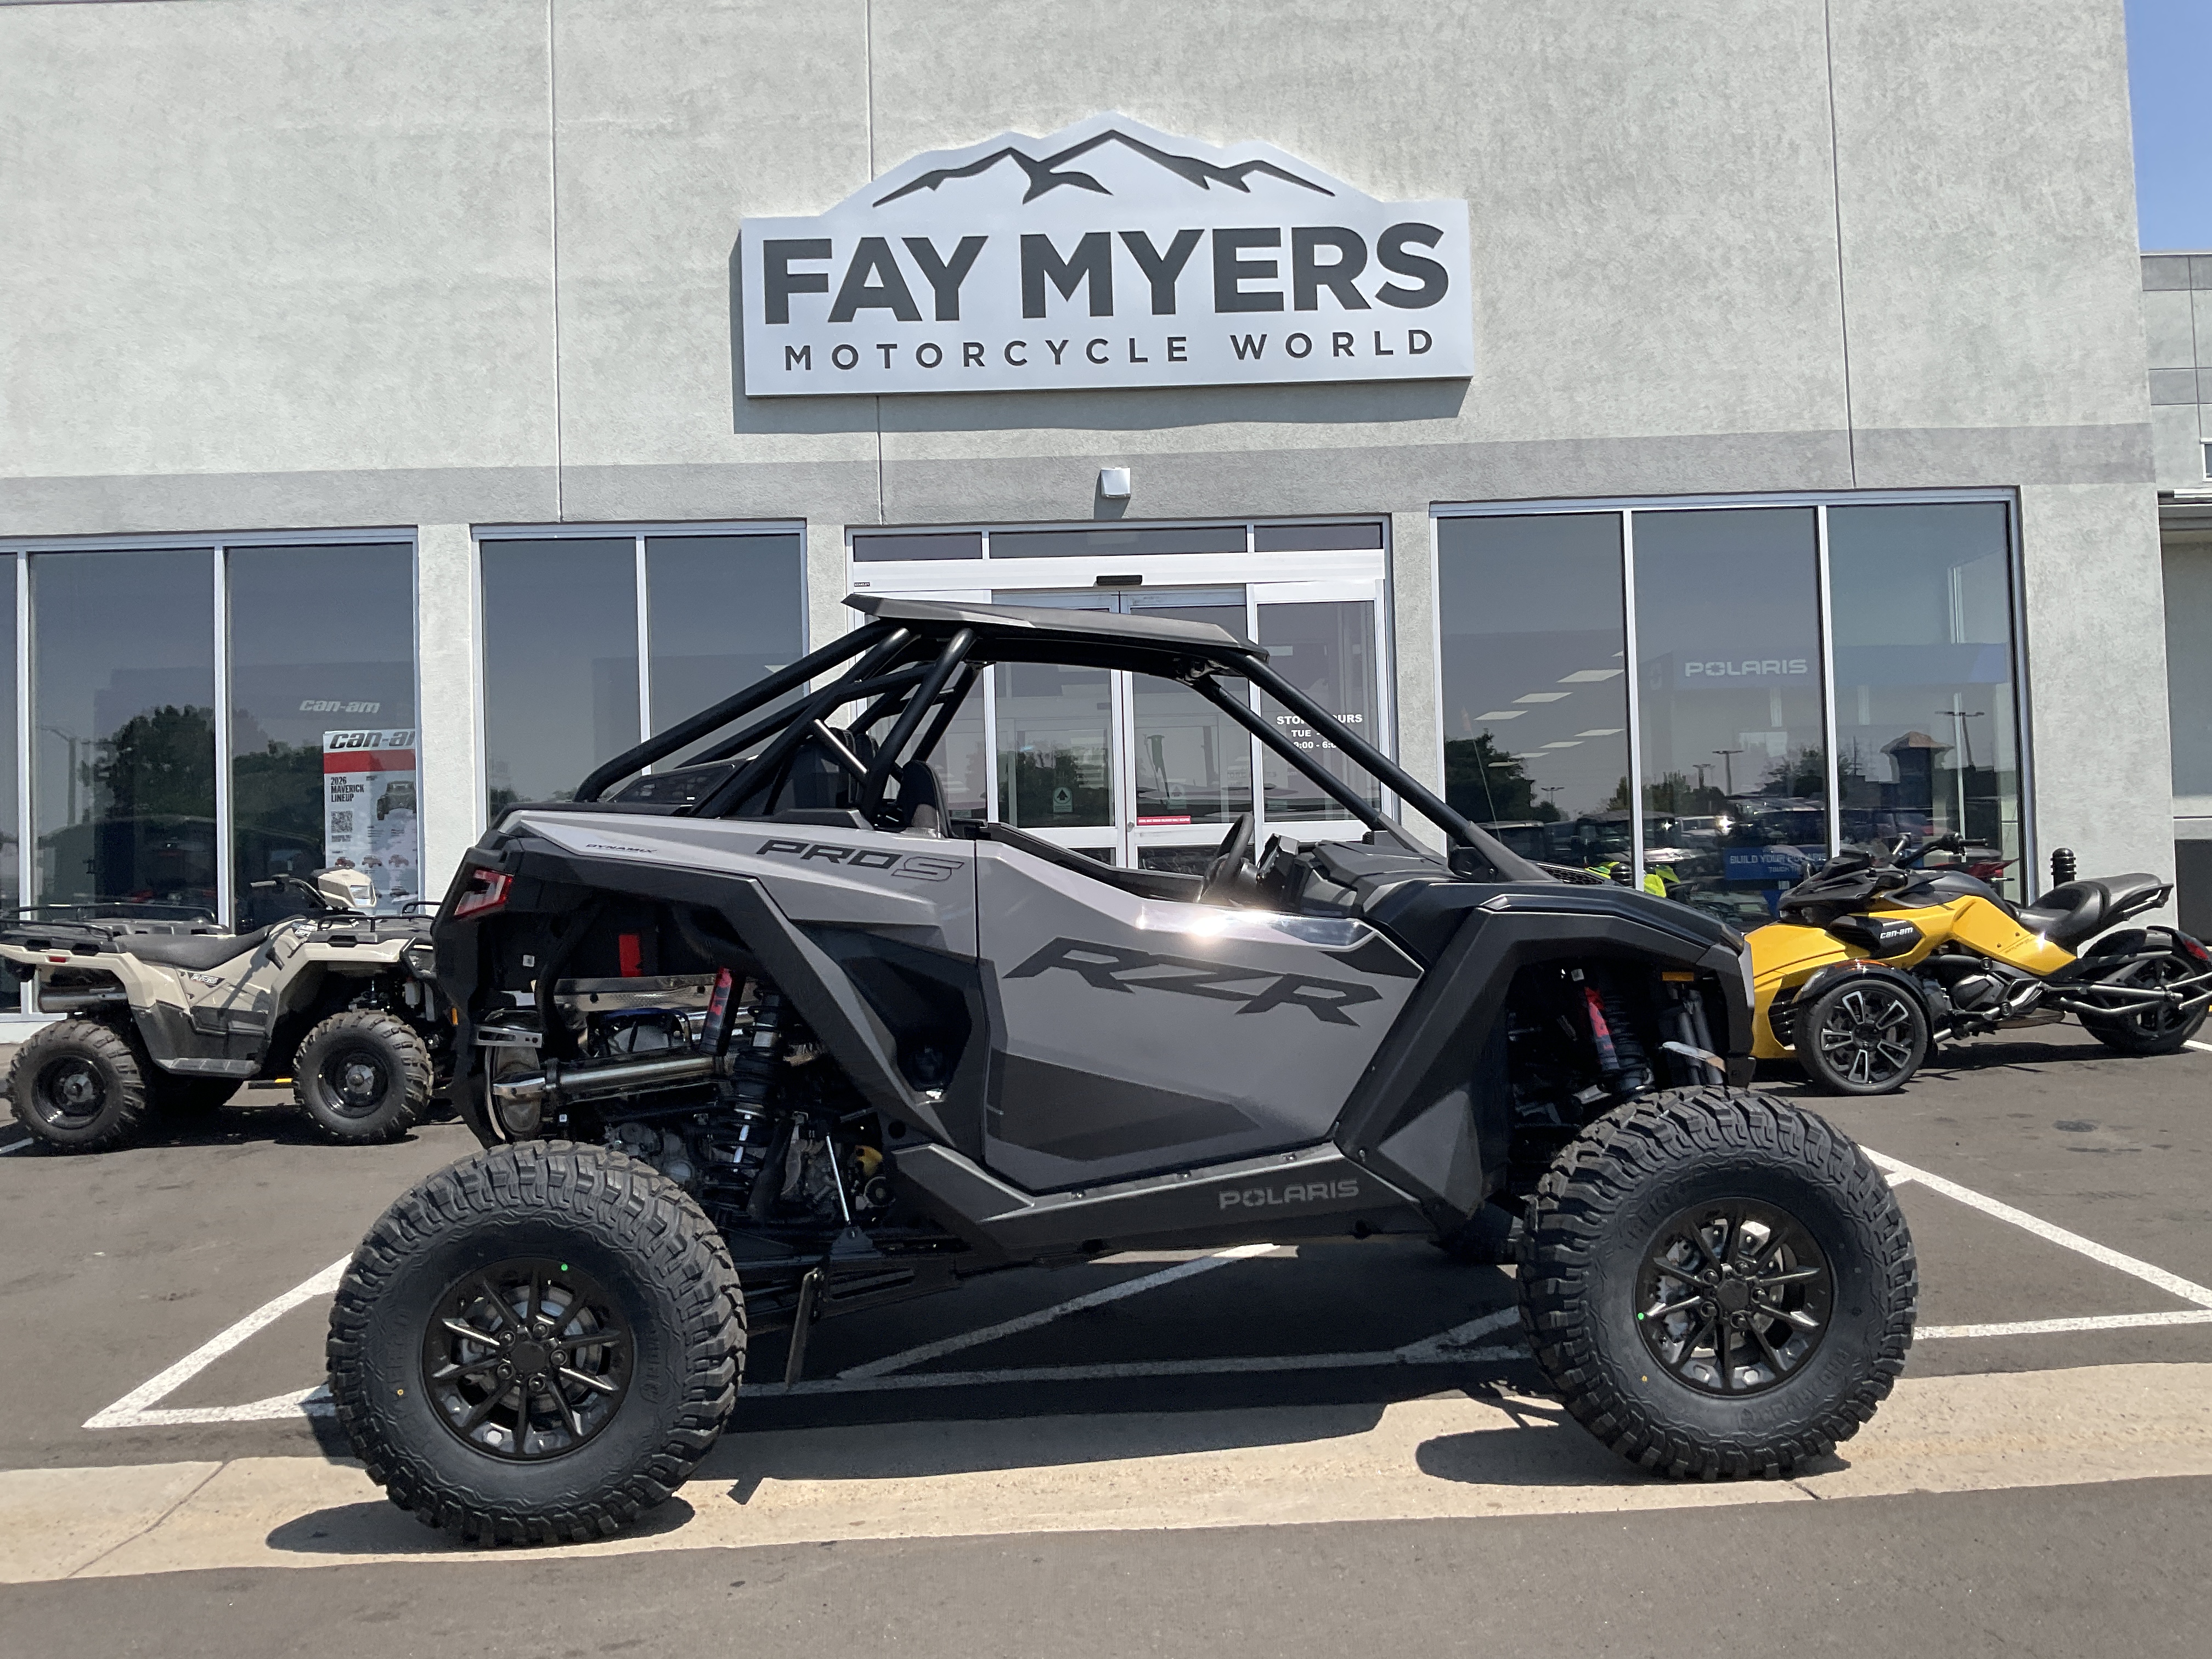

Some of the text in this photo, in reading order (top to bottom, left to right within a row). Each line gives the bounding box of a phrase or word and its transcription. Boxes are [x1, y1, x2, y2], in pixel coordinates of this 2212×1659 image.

[764, 222, 1449, 324] FAY MYERS
[785, 329, 1432, 370] MOTORCYCLE WORLD
[1685, 659, 1808, 677] POLARIS
[299, 699, 380, 713] can-am
[330, 776, 347, 785] 2026
[331, 785, 364, 794] MAVERICK
[331, 793, 354, 802] LINEUP
[586, 844, 657, 853] DYNAMIX
[1730, 854, 1758, 864] BUILD
[1760, 854, 1785, 863] YOUR
[1880, 927, 1914, 939] can-am
[1002, 936, 1383, 1026] RZR
[1218, 1179, 1359, 1210] POLARIS
